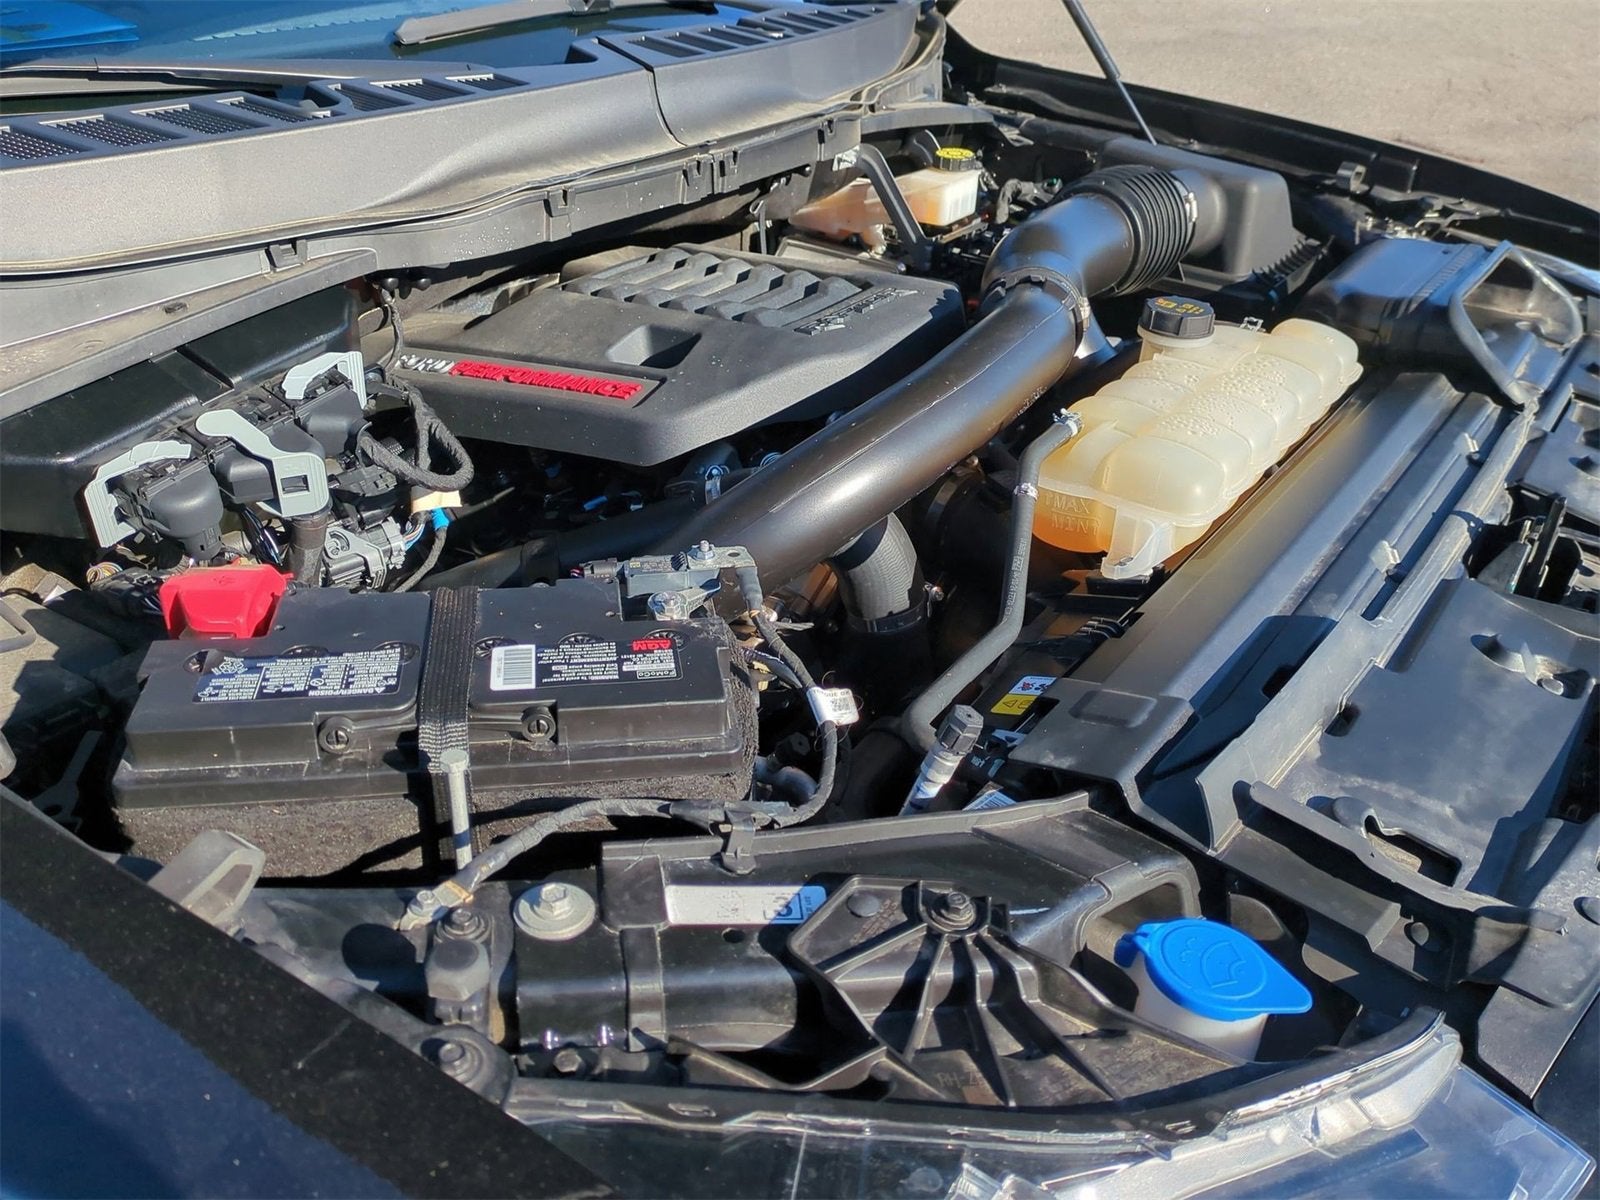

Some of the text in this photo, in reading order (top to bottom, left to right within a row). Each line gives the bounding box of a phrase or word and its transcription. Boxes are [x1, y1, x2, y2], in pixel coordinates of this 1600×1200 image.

[449, 359, 643, 400] PERFORMANCE
[1054, 495, 1090, 514] MAX
[1052, 514, 1089, 534] MIN
[632, 641, 669, 650] AGM
